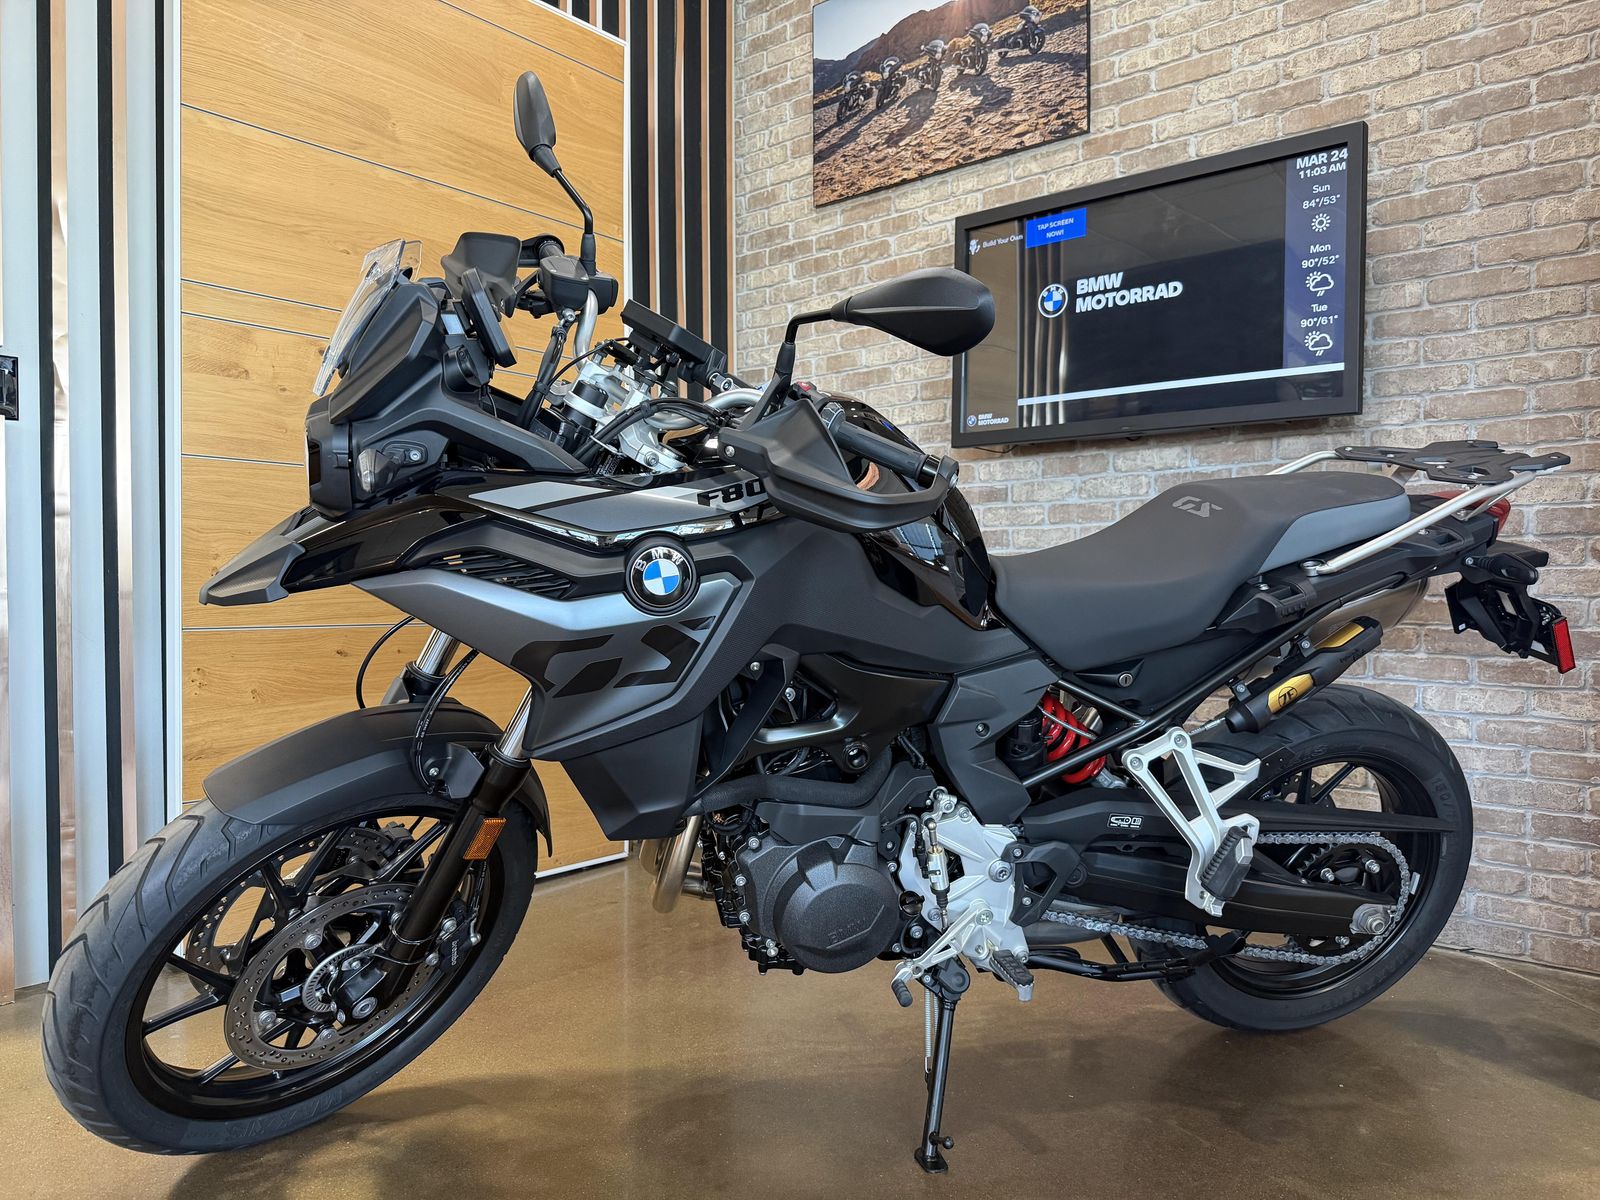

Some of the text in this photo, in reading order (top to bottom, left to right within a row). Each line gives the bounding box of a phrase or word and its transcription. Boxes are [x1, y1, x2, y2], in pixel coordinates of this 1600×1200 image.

[1296, 148, 1349, 170] MAR 24
[1299, 161, 1347, 179] 11:03 AM
[1312, 184, 1331, 194] Sun
[1302, 194, 1341, 209] 84°/53°
[1037, 218, 1075, 231] TAP SCREEN
[982, 234, 1024, 248] Build Your Own
[1046, 230, 1065, 238] NOW!
[1309, 244, 1331, 254] Mon
[1301, 254, 1340, 269] 90°/52°
[1076, 271, 1124, 295] BMW
[1075, 281, 1184, 313] MOTORRAD
[1310, 303, 1329, 313] Tue
[1300, 314, 1339, 328] 90°/61°
[1172, 496, 1223, 518] GS
[634, 548, 684, 571] BMW
